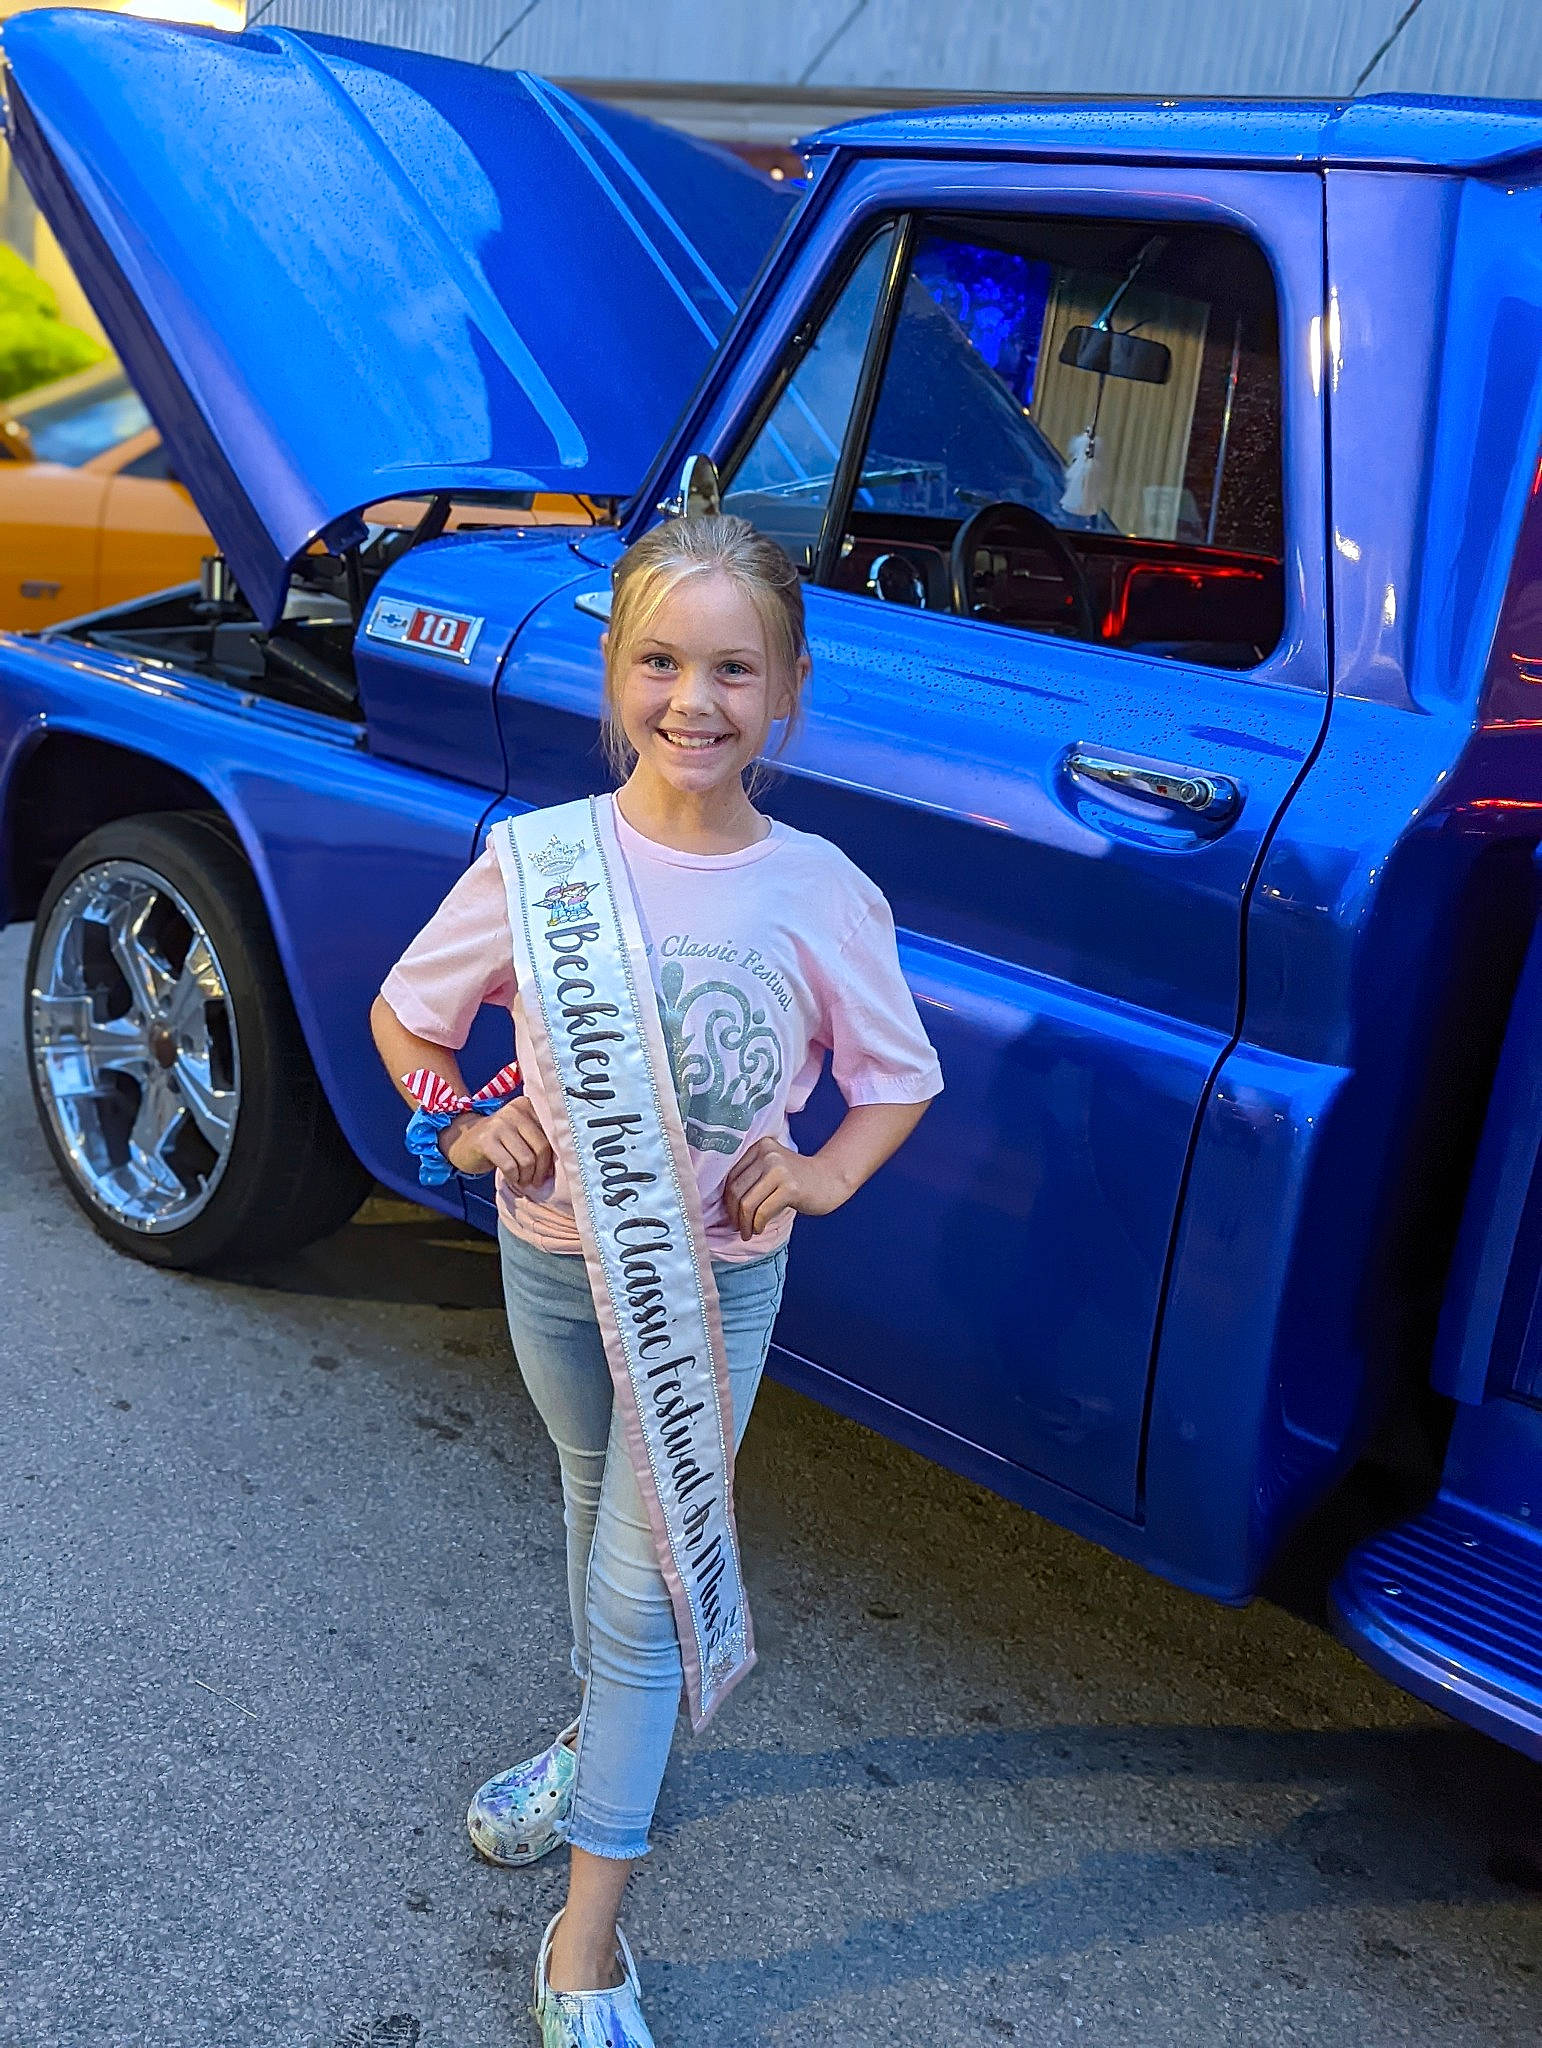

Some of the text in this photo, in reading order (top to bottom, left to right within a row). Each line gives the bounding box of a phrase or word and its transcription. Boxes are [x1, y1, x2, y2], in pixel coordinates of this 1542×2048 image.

[420, 614, 459, 647] 10
[545, 922, 625, 1109] Beckley
[660, 934, 793, 1013] Classic Festival
[587, 1113, 658, 1212] Kids
[614, 1216, 678, 1360] Classic
[647, 1355, 715, 1504] Festival
[692, 1534, 726, 1633] Miss
